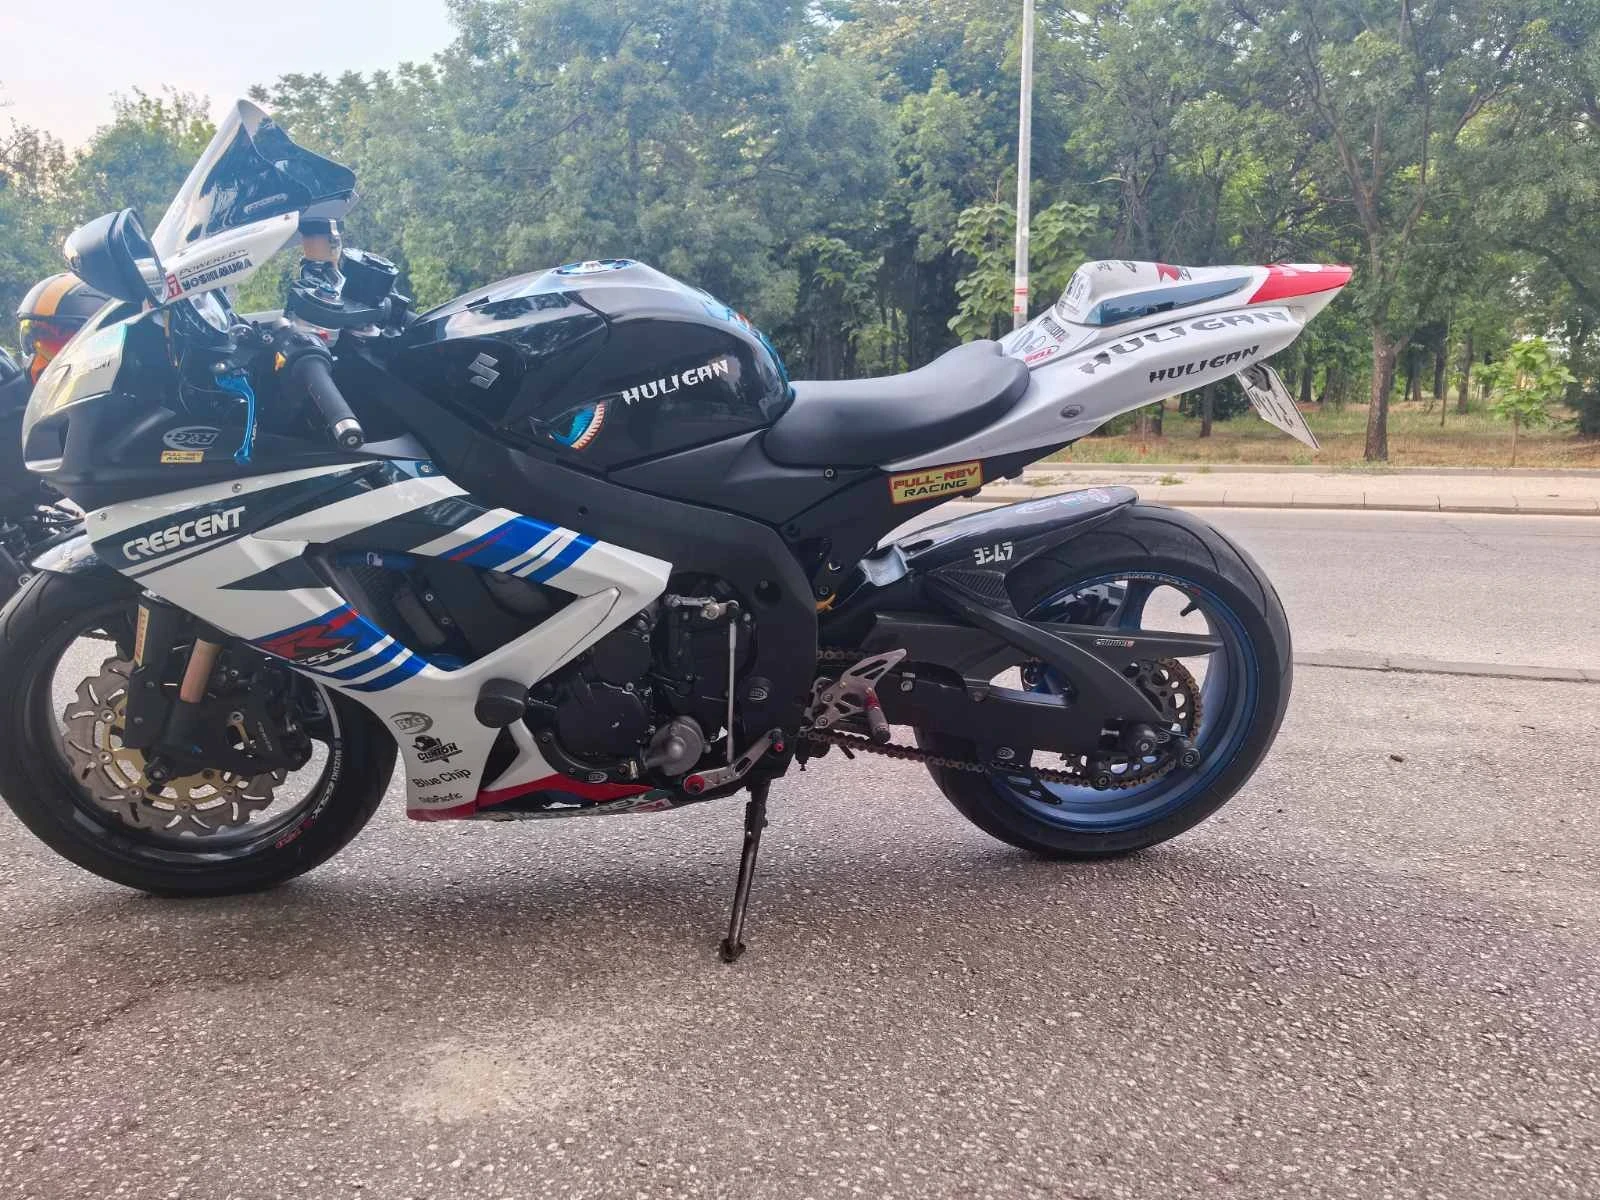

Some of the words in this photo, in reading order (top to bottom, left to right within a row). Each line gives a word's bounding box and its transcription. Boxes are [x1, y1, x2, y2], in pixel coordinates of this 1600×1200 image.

[1080, 308, 1290, 375] HULIGAN
[621, 359, 730, 406] HULIGAN
[1149, 345, 1260, 383] HULIGAN
[893, 466, 978, 489] PULL-REV
[904, 479, 968, 498] RACING
[122, 506, 246, 560] CRESCENT
[412, 777, 442, 788] Blue
[439, 768, 472, 783] Chip
